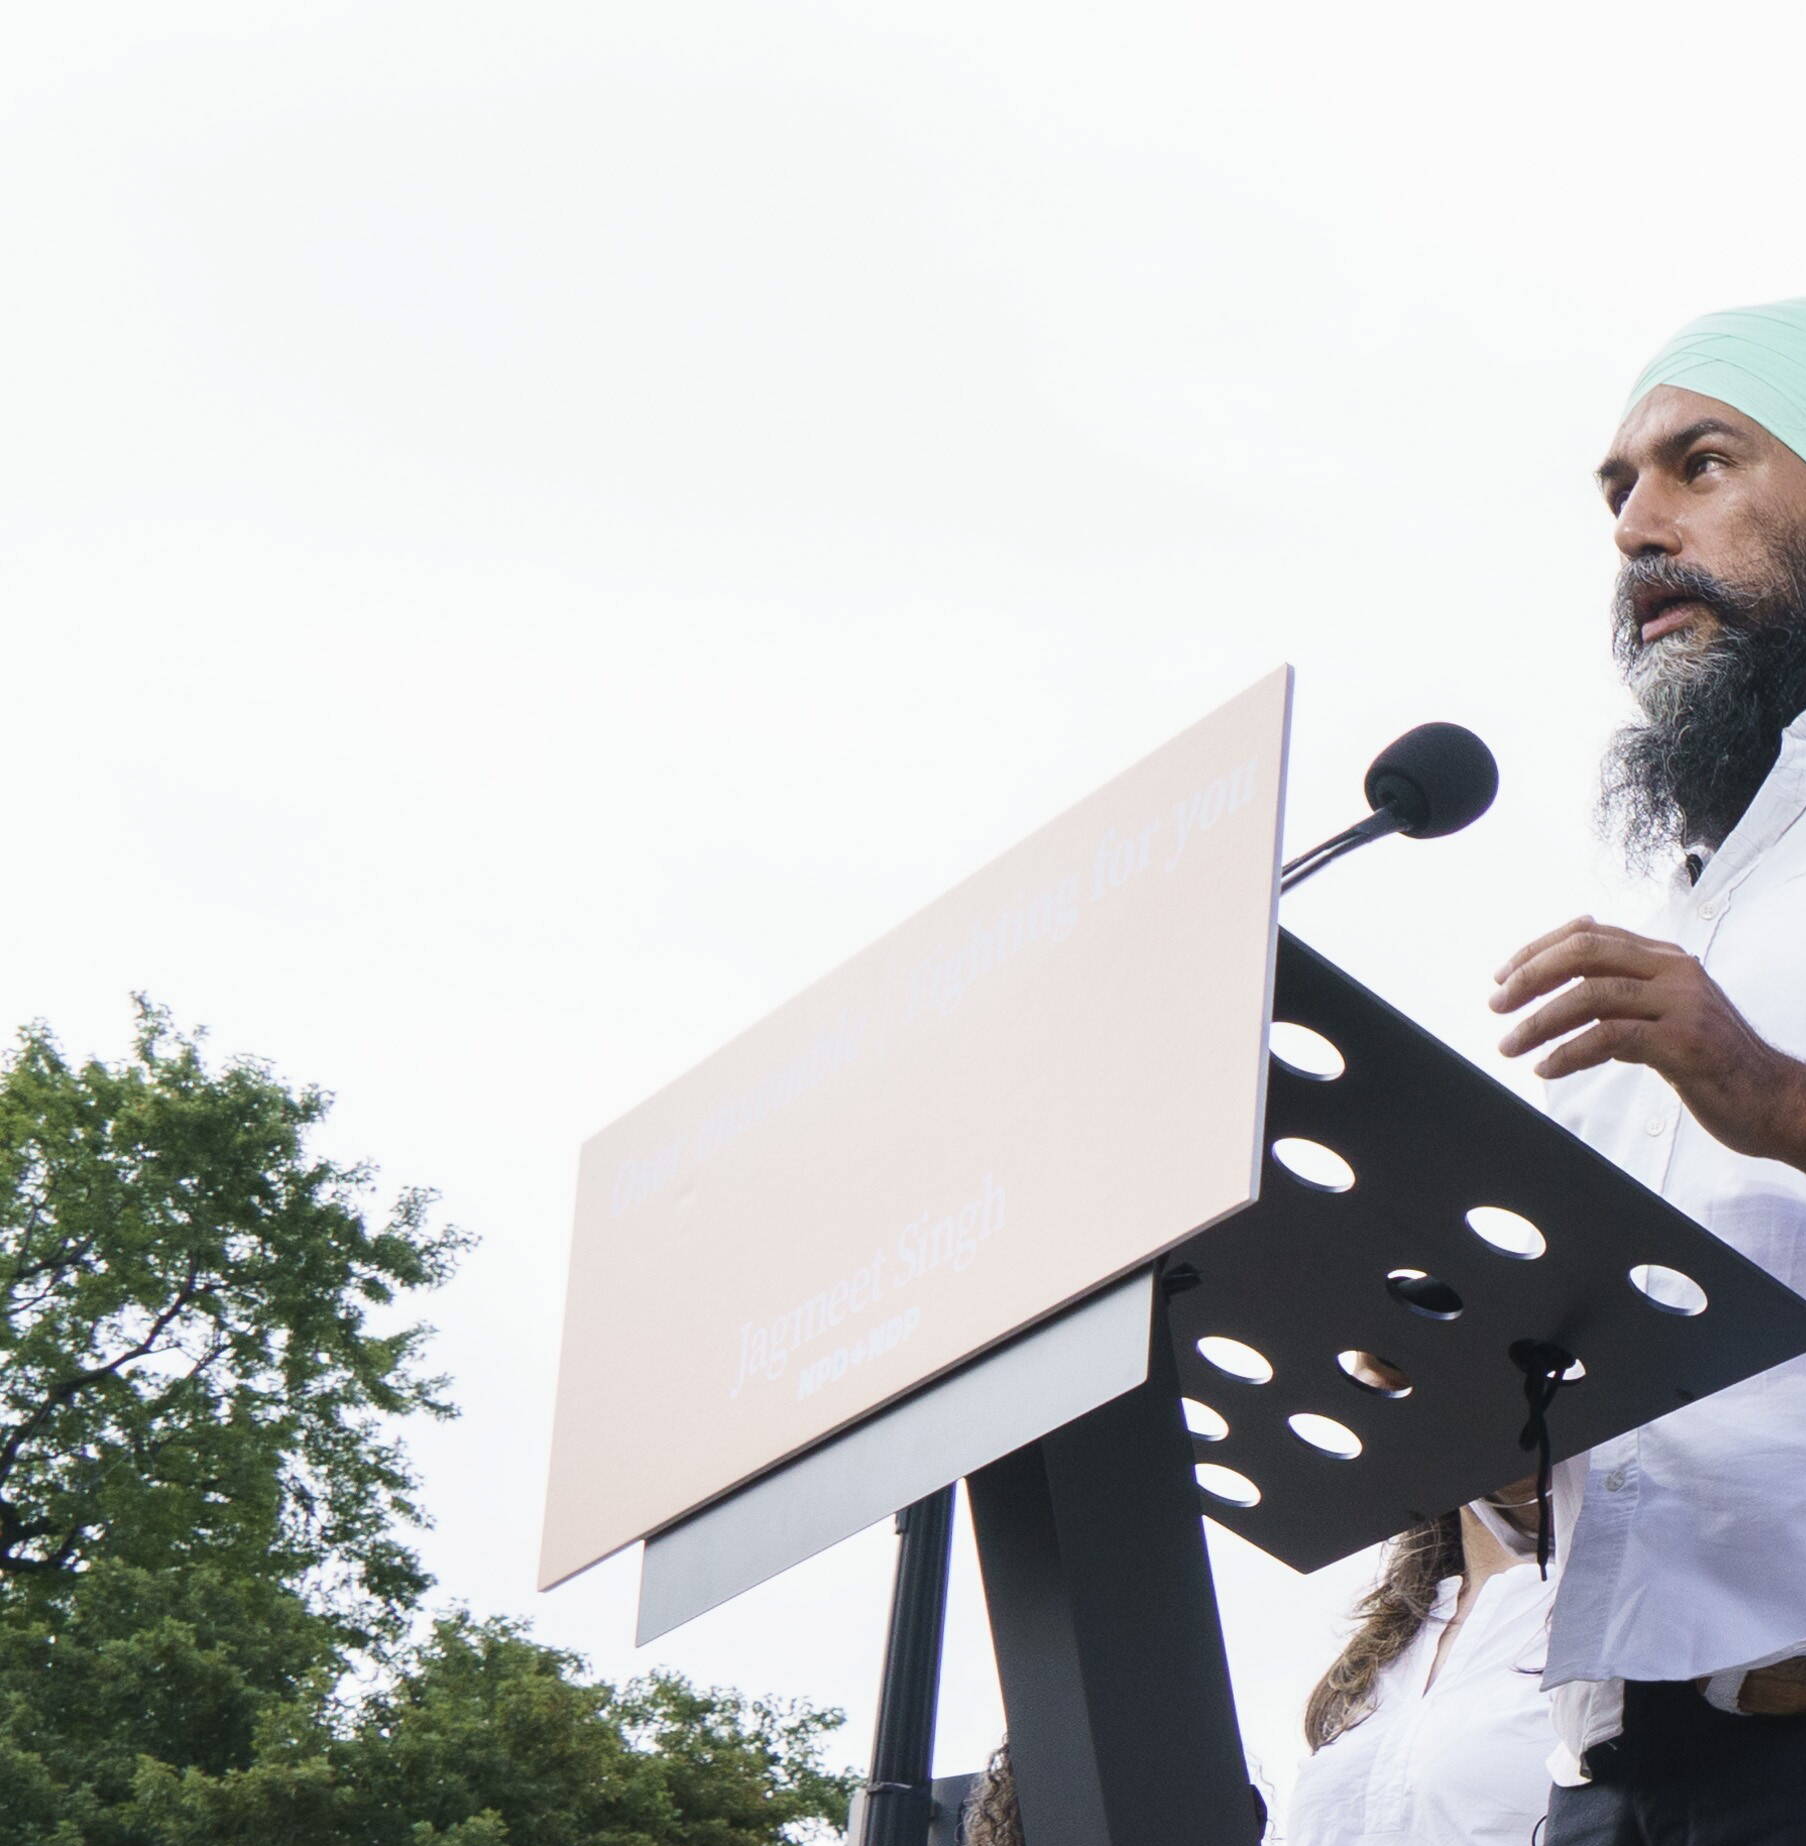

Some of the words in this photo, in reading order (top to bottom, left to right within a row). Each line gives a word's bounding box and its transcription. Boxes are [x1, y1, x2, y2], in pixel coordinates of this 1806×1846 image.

[1092, 816, 1161, 904] for
[1164, 756, 1258, 874] you
[727, 1247, 884, 1399] Jagmeet
[893, 1170, 1006, 1287] Singh
